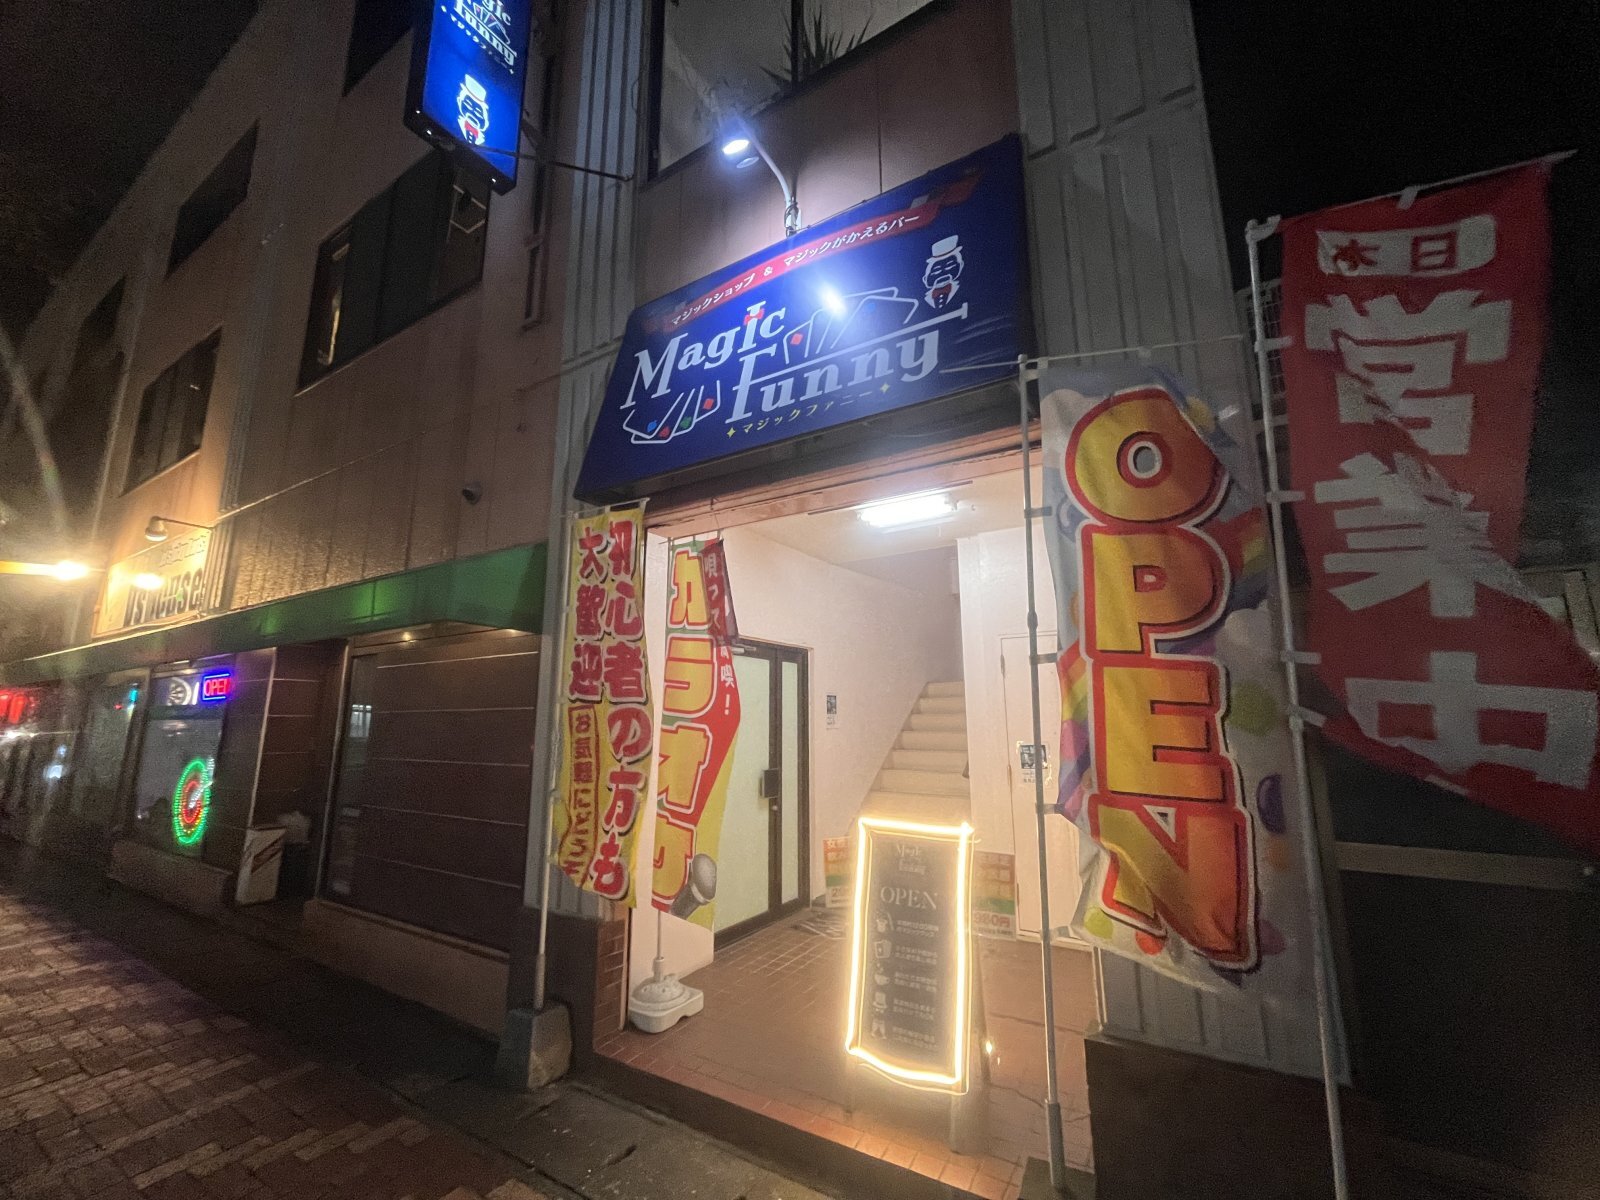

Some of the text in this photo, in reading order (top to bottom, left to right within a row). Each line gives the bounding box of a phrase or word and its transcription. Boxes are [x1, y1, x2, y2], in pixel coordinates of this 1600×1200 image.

[726, 310, 962, 424] Funny
[1062, 385, 1258, 970] OPEN
[880, 886, 938, 909] OPEN
